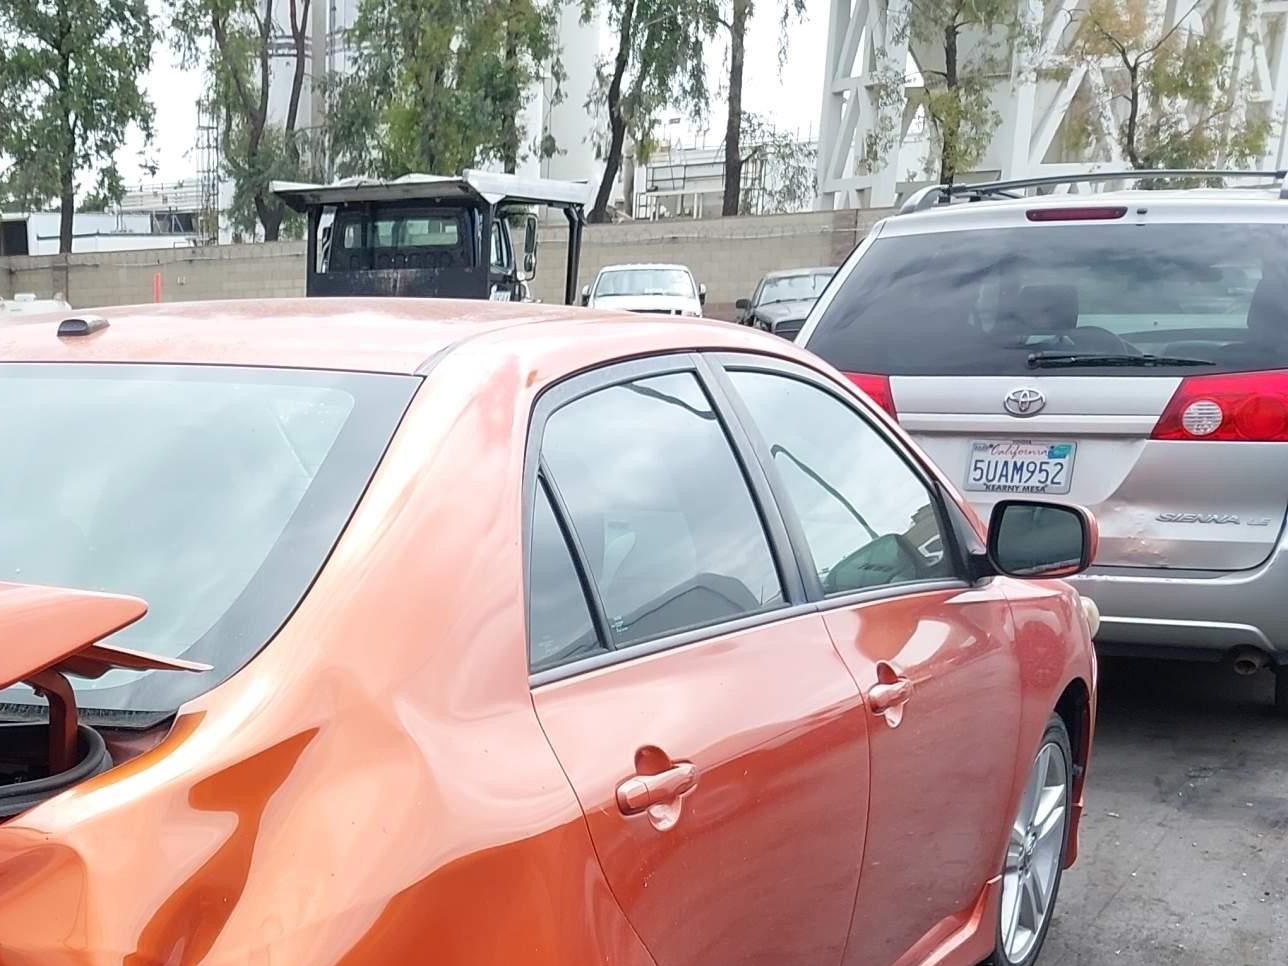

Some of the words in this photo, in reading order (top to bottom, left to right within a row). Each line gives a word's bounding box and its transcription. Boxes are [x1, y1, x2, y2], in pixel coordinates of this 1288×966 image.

[990, 444, 1048, 460] California
[972, 459, 1065, 486] 5UAM952
[1155, 512, 1241, 525] SIENNA
